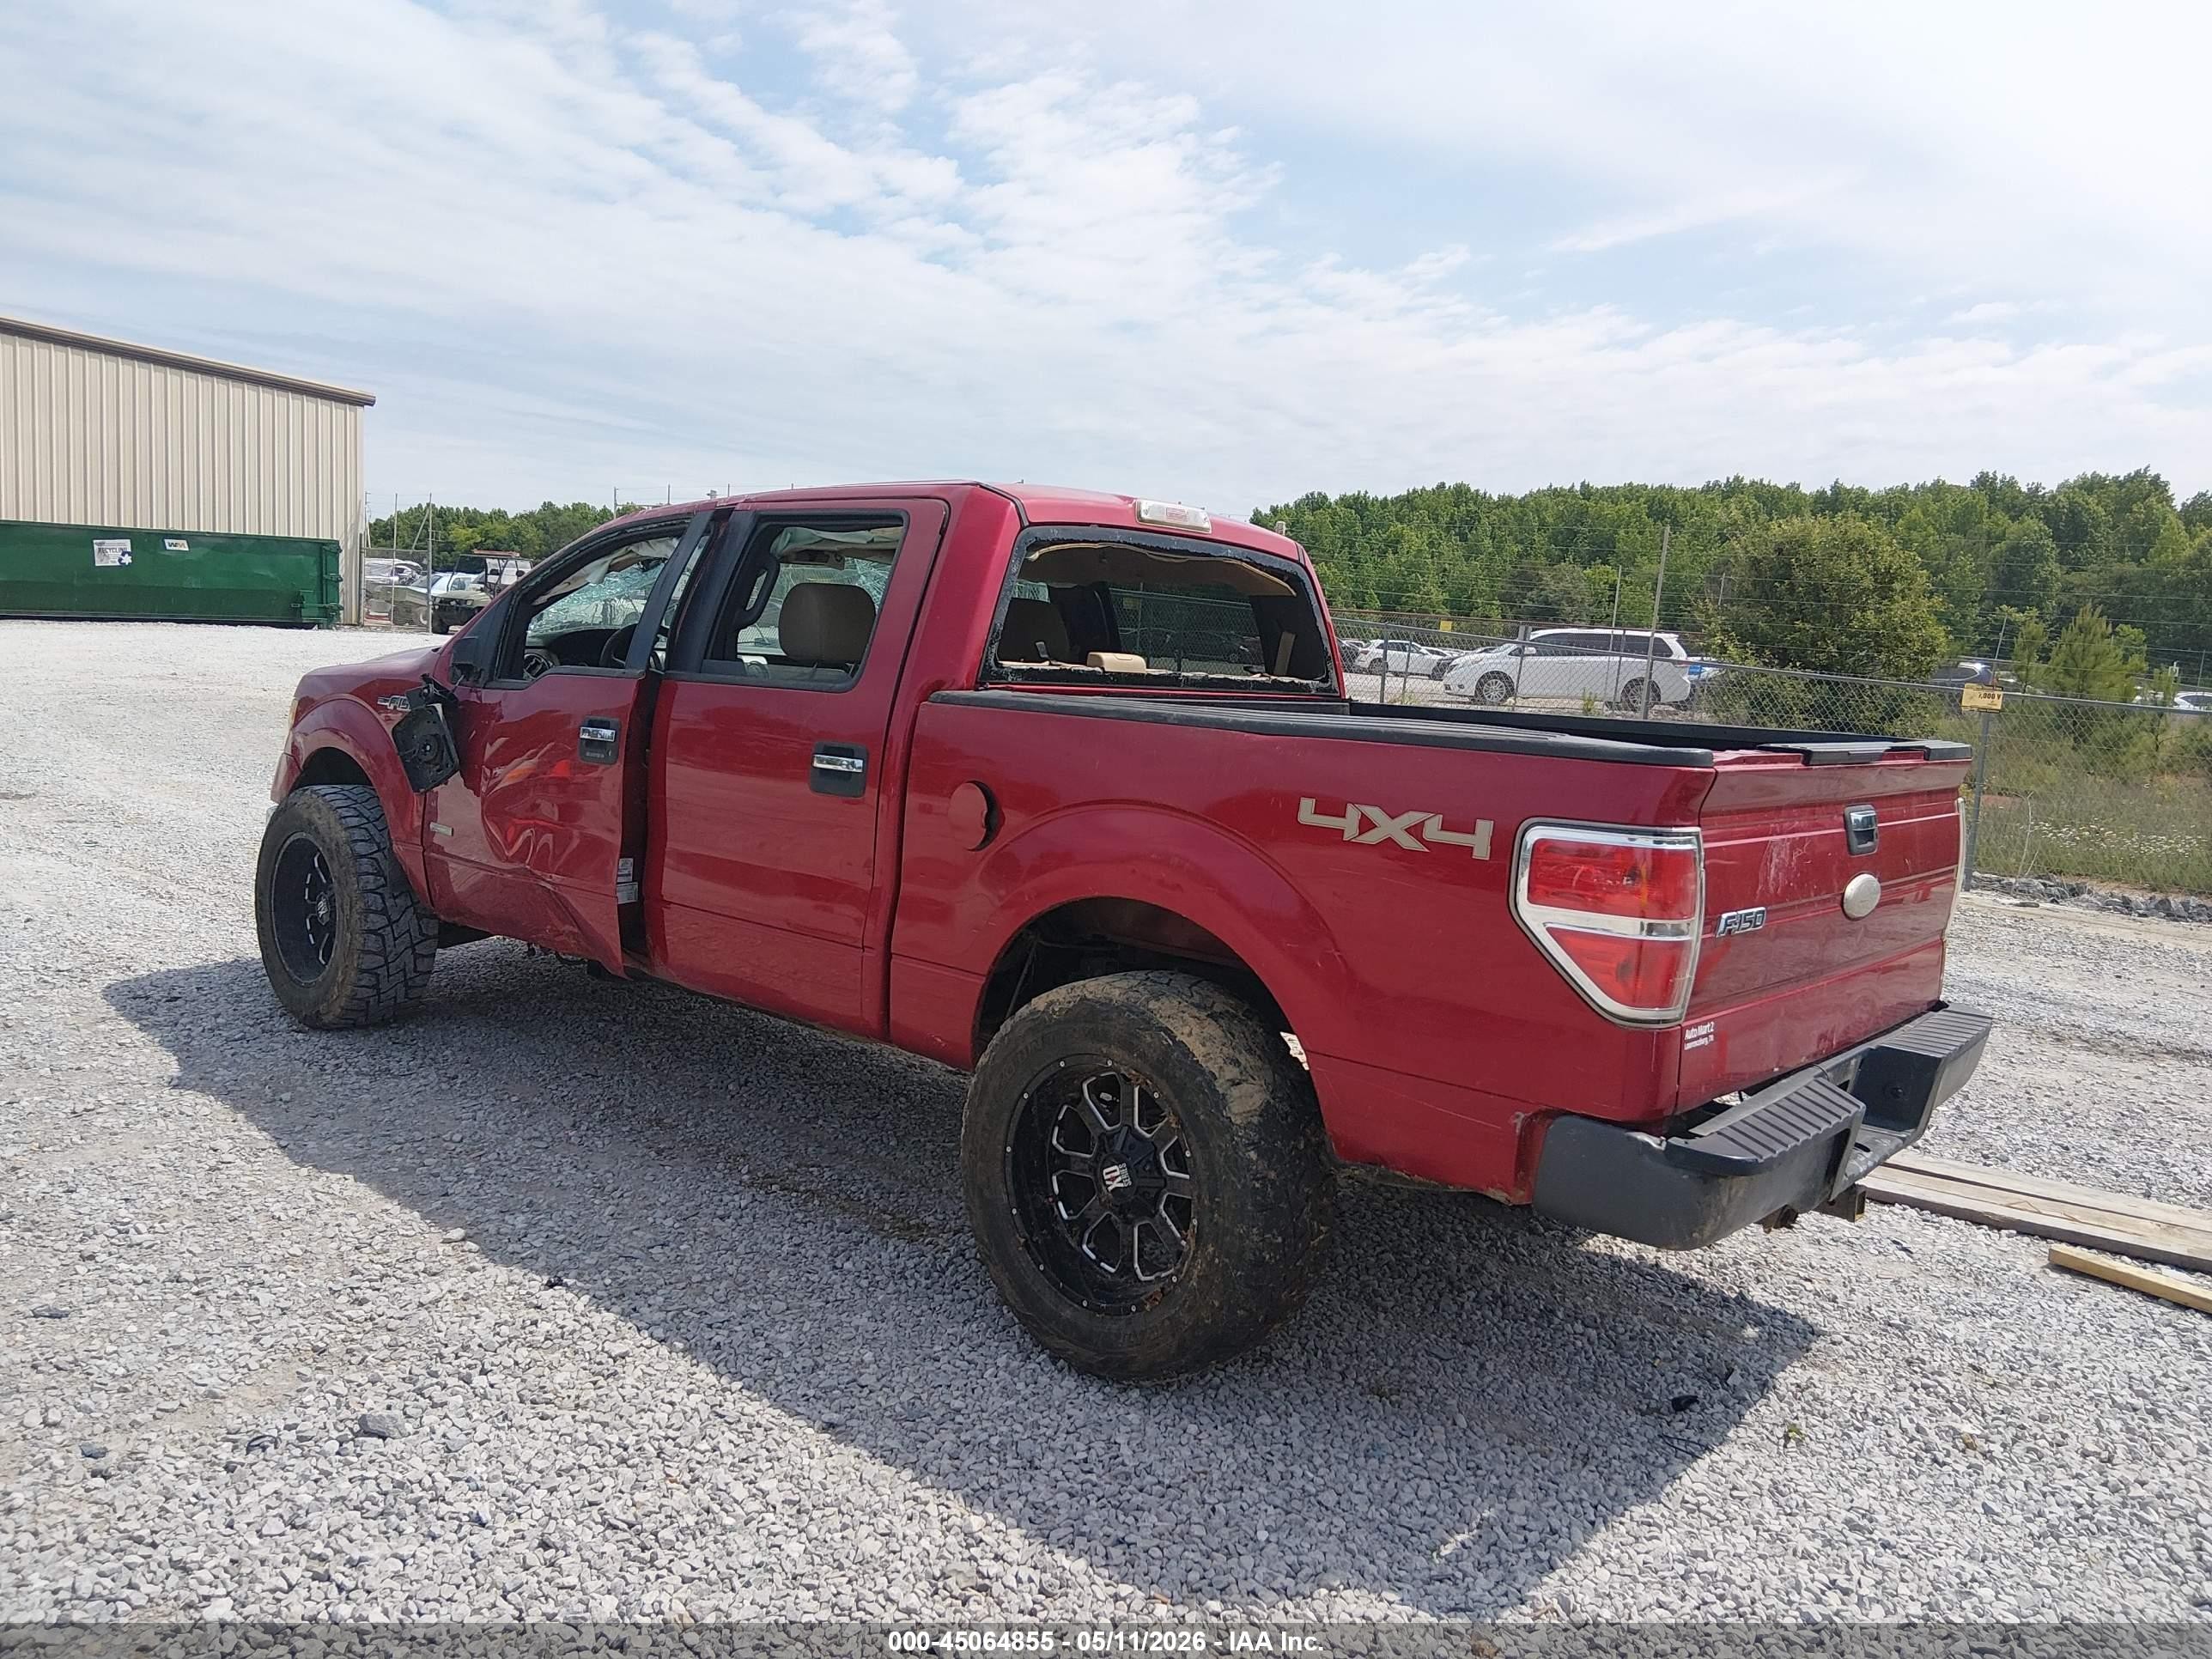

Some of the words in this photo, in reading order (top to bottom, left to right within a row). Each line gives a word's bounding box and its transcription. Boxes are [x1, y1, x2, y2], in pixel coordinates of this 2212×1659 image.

[1297, 797, 1494, 860] 4X4
[1684, 1026, 1698, 1041] Auto
[1103, 1164, 1124, 1193] XD
[1118, 1162, 1133, 1188] SERIES
